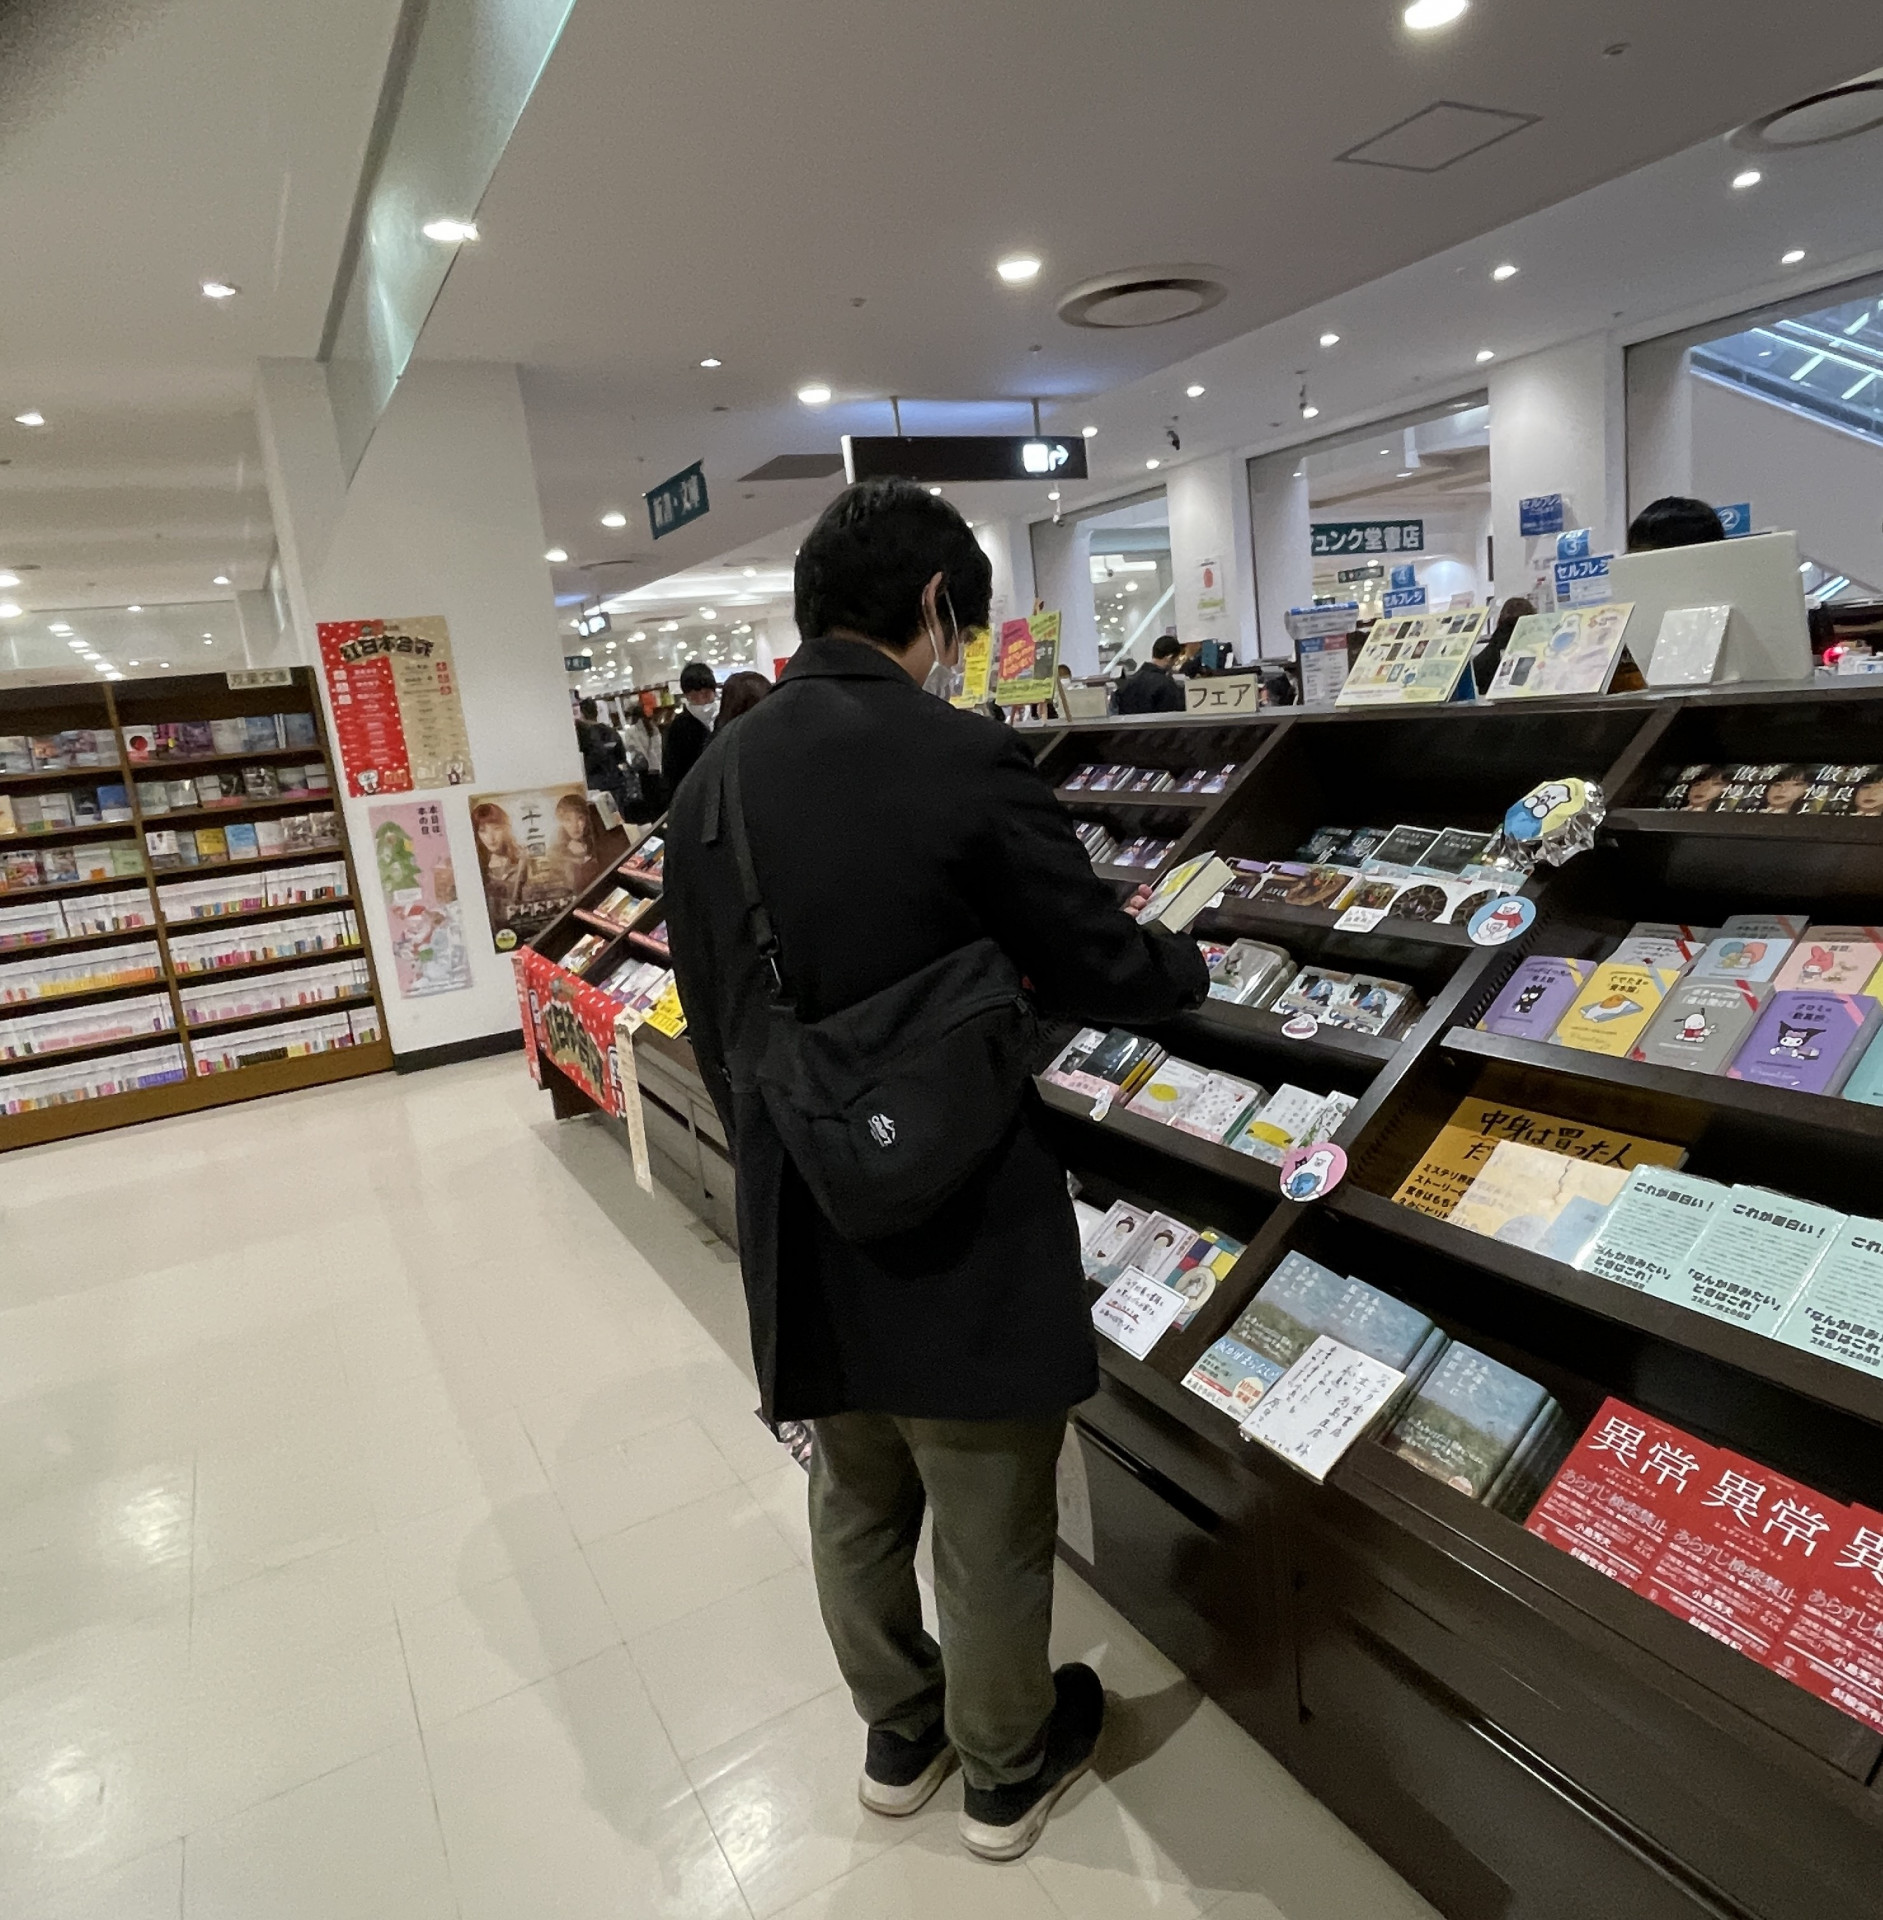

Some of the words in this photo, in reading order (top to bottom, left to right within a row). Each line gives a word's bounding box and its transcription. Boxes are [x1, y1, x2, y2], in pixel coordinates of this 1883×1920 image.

[1311, 525, 1420, 552] ュンク堂書店
[1189, 684, 1251, 708] フェア
[1589, 1416, 1700, 1495] 異常
[1561, 1469, 1668, 1535] あらすじ検索禁止
[1701, 1469, 1831, 1557] 異常
[1673, 1529, 1799, 1606] あらすじ検索禁止
